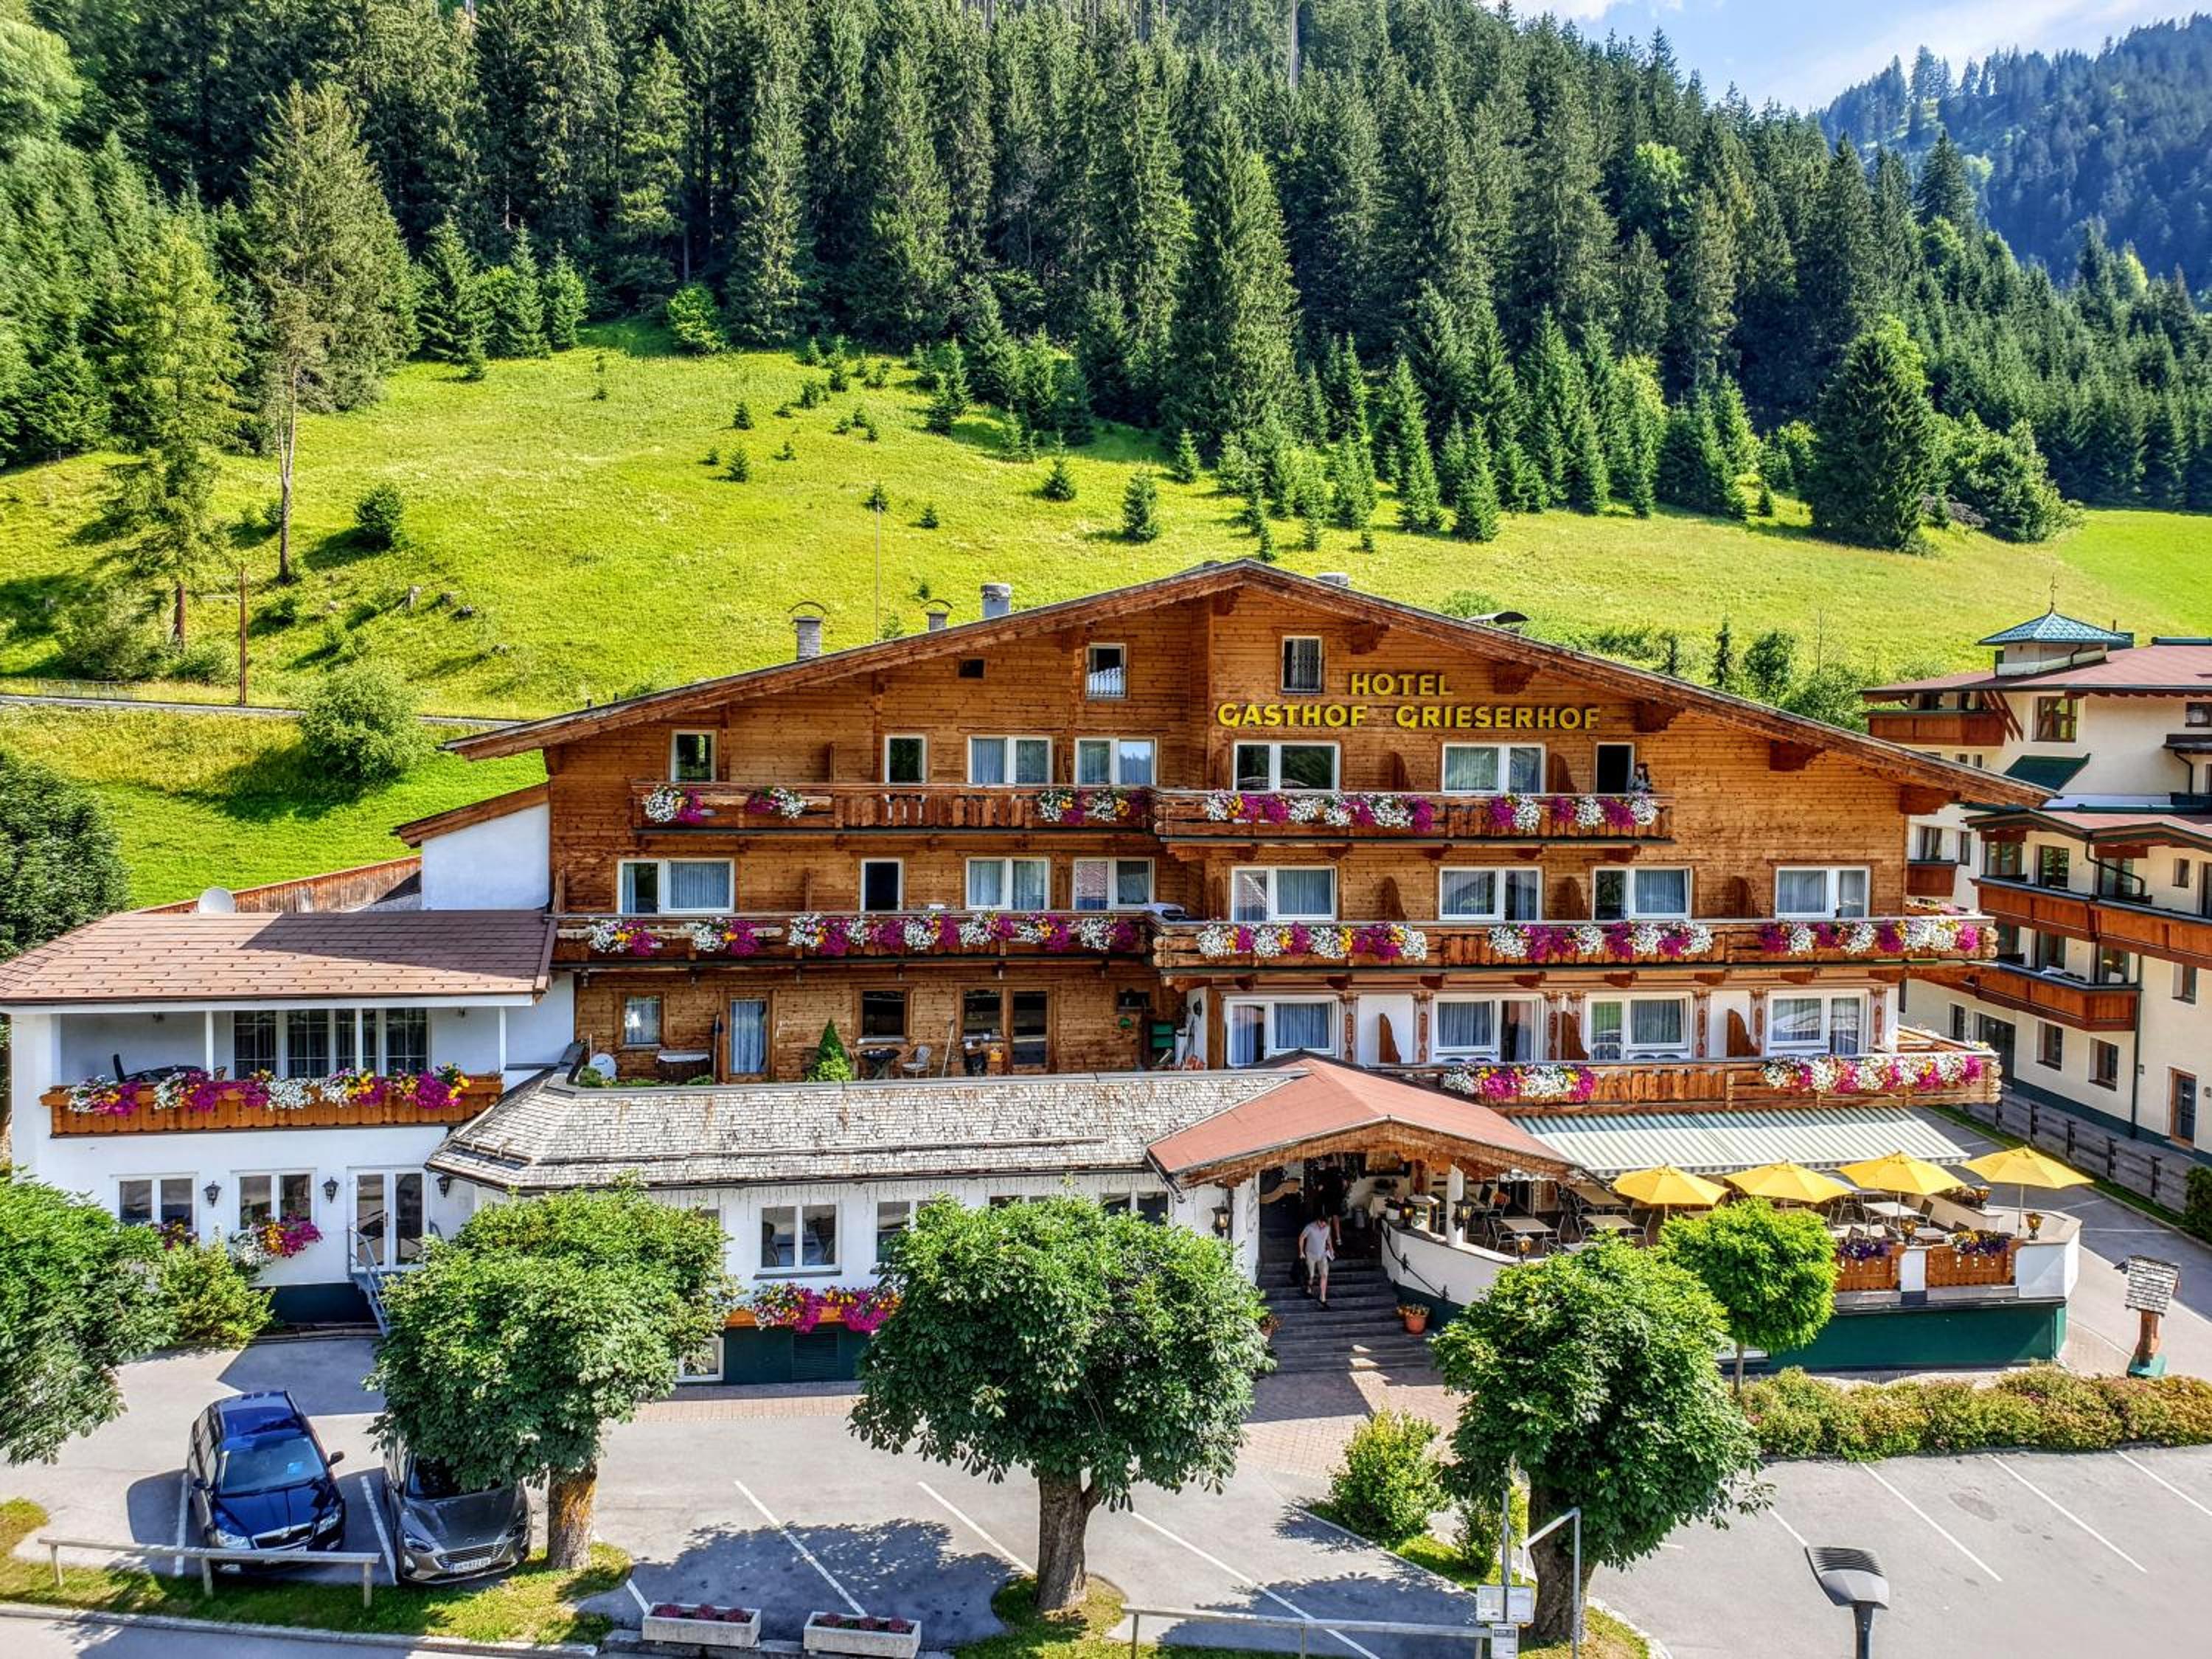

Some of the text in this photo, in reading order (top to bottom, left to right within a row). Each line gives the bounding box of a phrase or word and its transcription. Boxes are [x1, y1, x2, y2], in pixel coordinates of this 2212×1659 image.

[1351, 673, 1454, 697] HOTEL
[1217, 703, 1601, 729] GASTHOF GRIESERHOF
